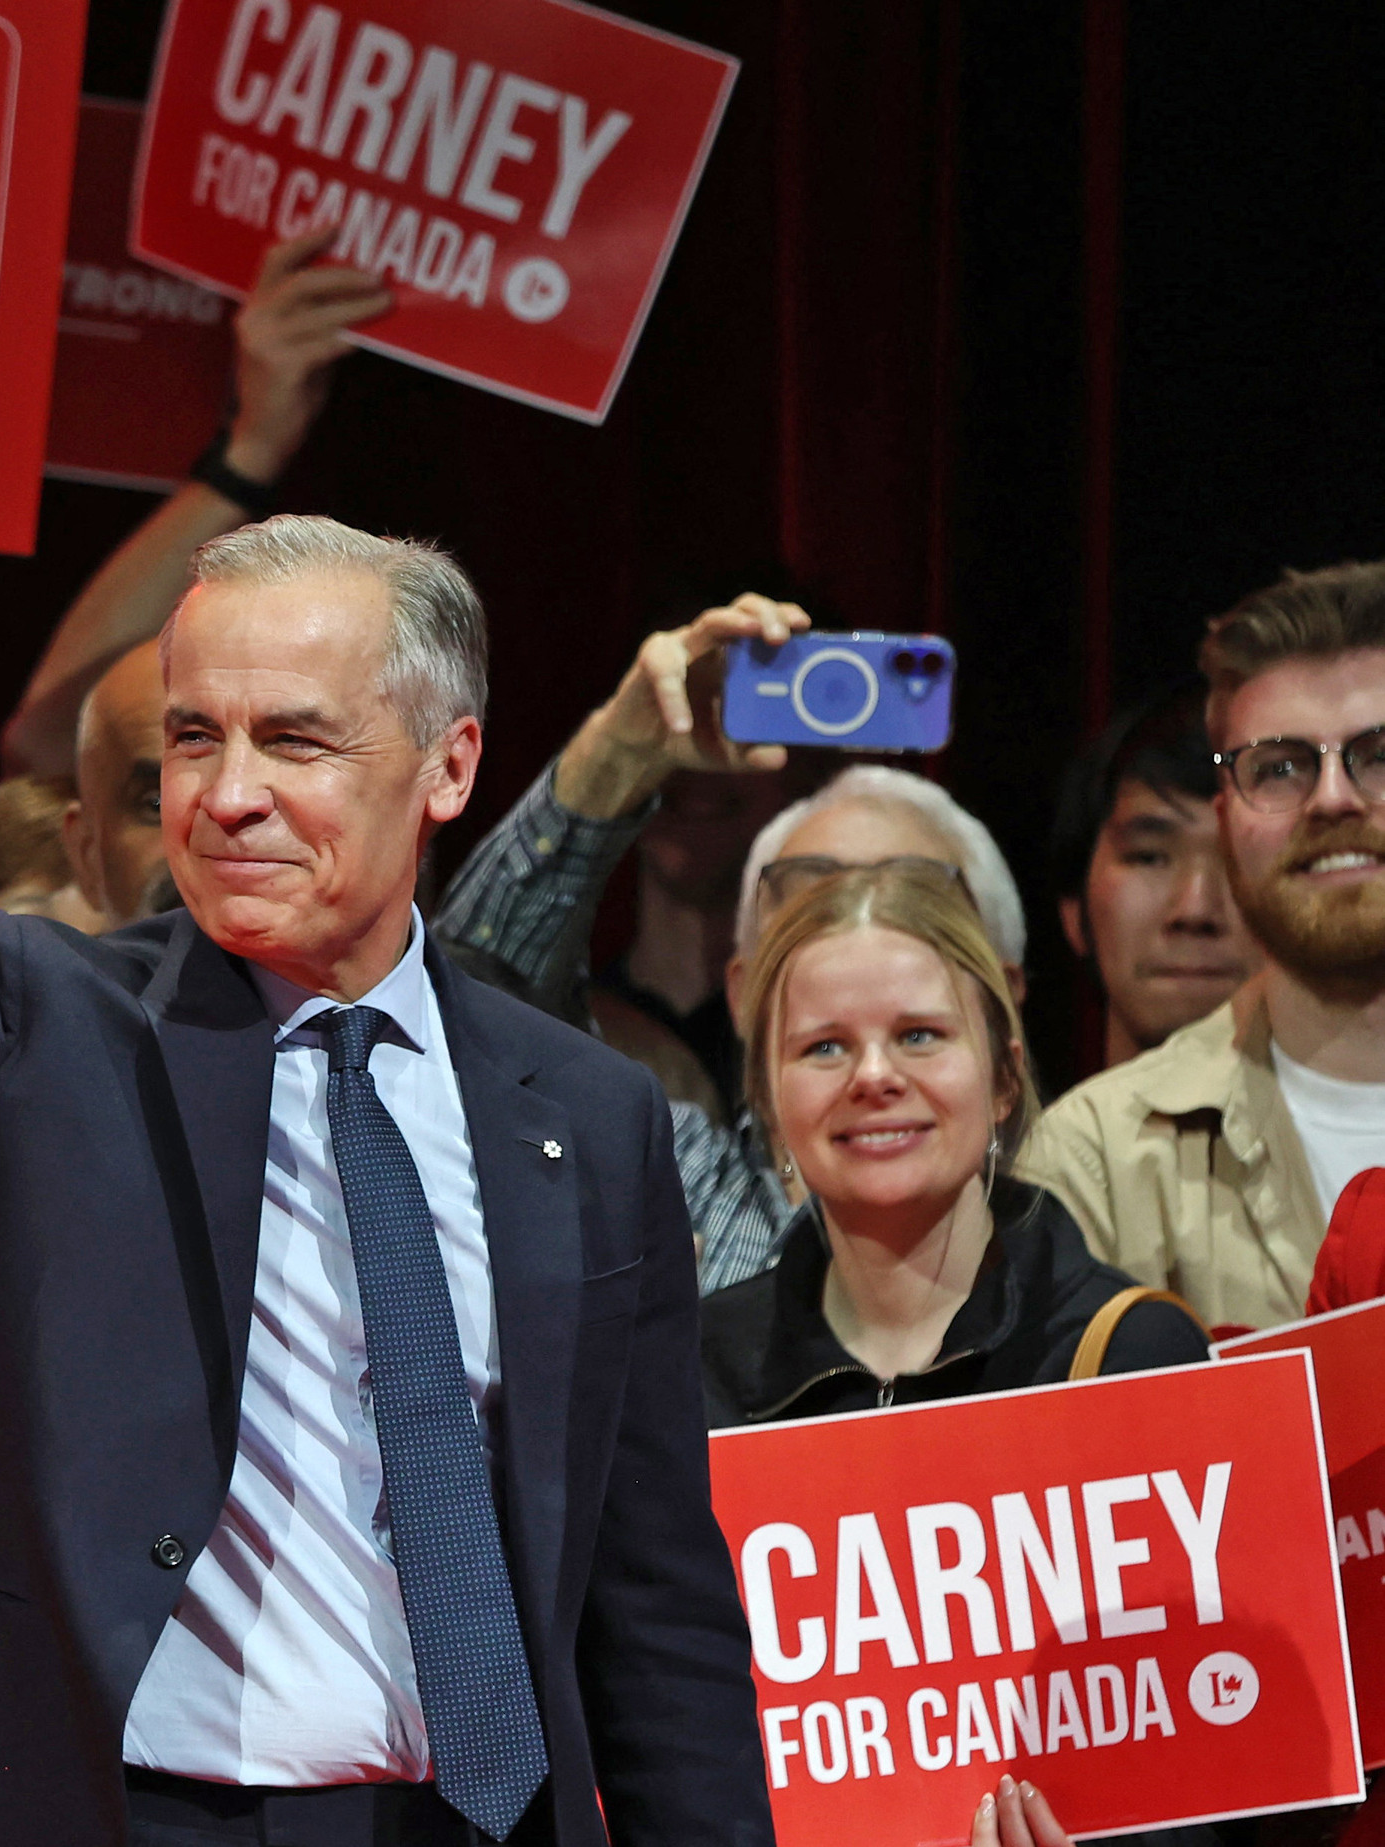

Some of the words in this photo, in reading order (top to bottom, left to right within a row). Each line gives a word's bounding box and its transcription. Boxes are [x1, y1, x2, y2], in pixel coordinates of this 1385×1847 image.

[191, 131, 279, 230] FOR
[275, 167, 497, 309] CANADA
[216, 0, 633, 240] CARNEY
[740, 1461, 1233, 1684] CARNEY
[762, 1696, 897, 1789] FOR
[907, 1657, 1177, 1772] CANADA
